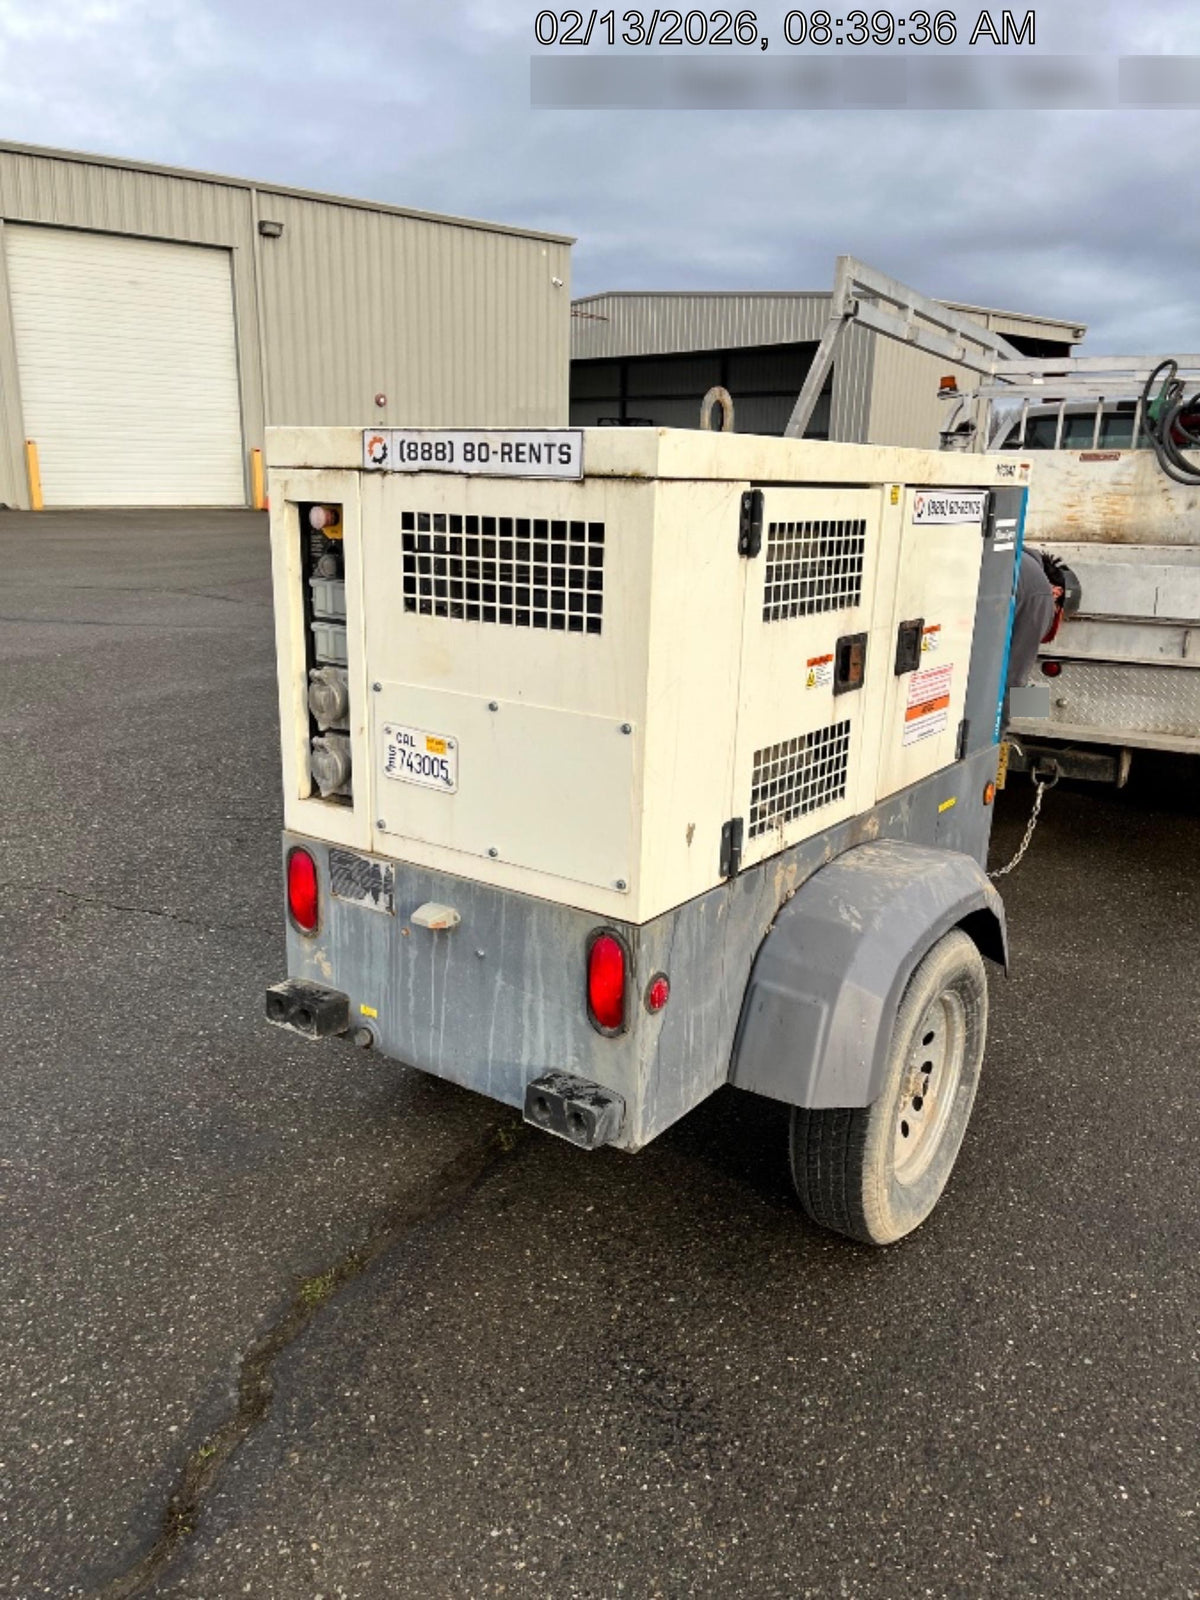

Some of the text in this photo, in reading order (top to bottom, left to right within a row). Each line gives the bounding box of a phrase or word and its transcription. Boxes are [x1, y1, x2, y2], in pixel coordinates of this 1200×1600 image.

[399, 440, 572, 464] (888) 80-RENTS
[396, 732, 416, 747] CAL
[398, 747, 449, 781] 743005
